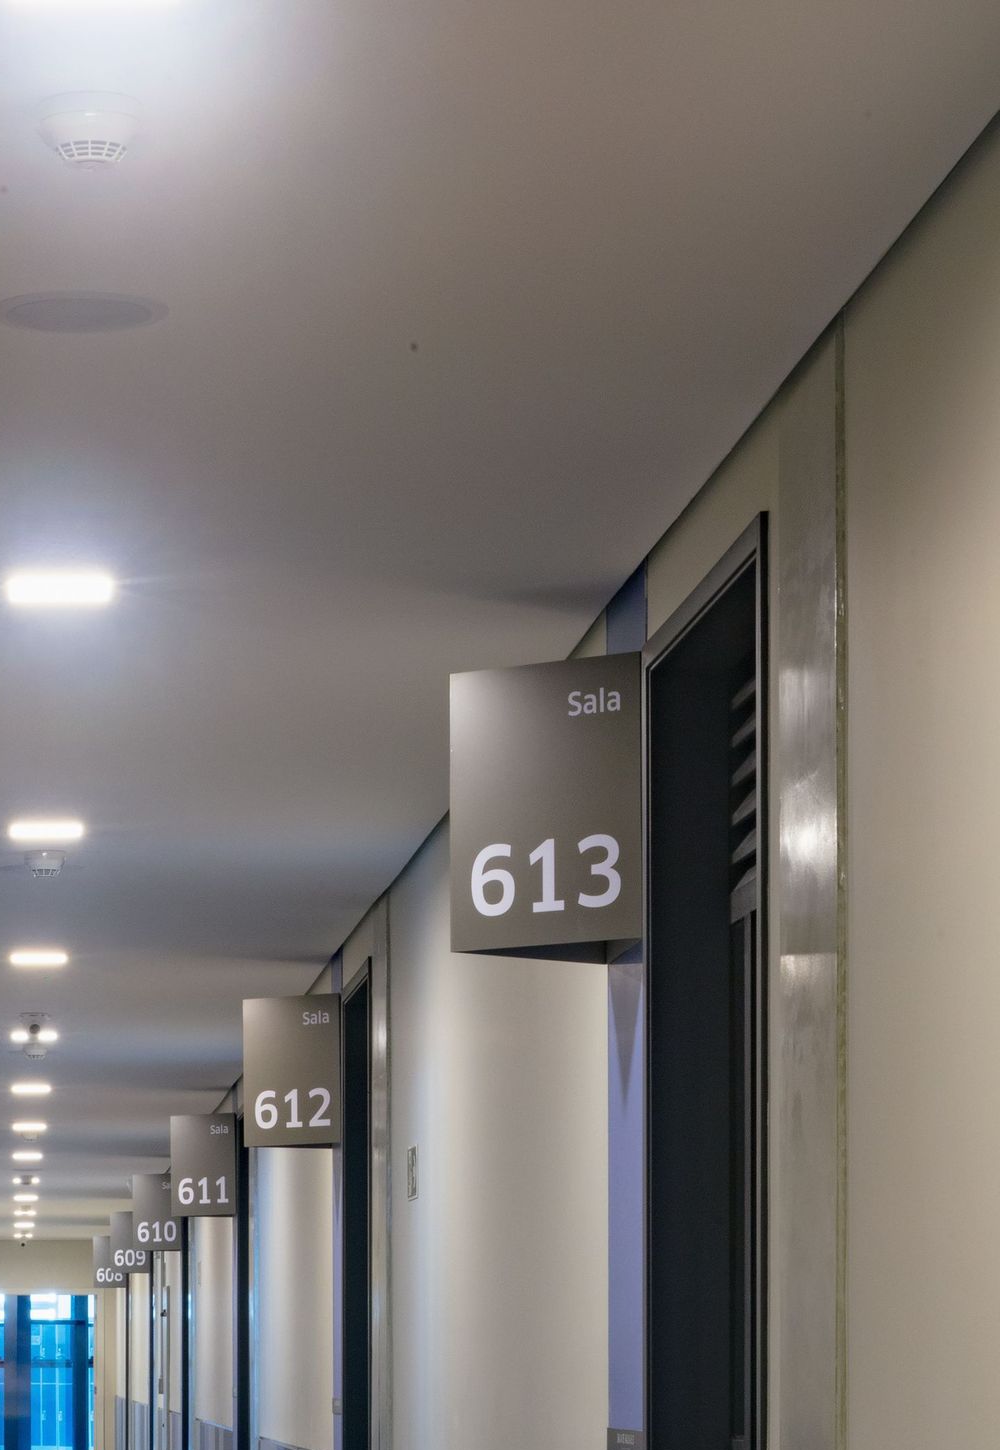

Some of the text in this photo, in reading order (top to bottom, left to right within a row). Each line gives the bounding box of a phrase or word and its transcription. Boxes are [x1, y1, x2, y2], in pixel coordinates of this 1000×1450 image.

[567, 687, 621, 717] Sala
[470, 834, 621, 917] 613
[302, 1011, 330, 1026] Sala
[254, 1088, 331, 1129] 612
[210, 1124, 229, 1135] Sala
[178, 1176, 229, 1205] 611
[137, 1221, 176, 1243] 610
[114, 1249, 146, 1267] 609
